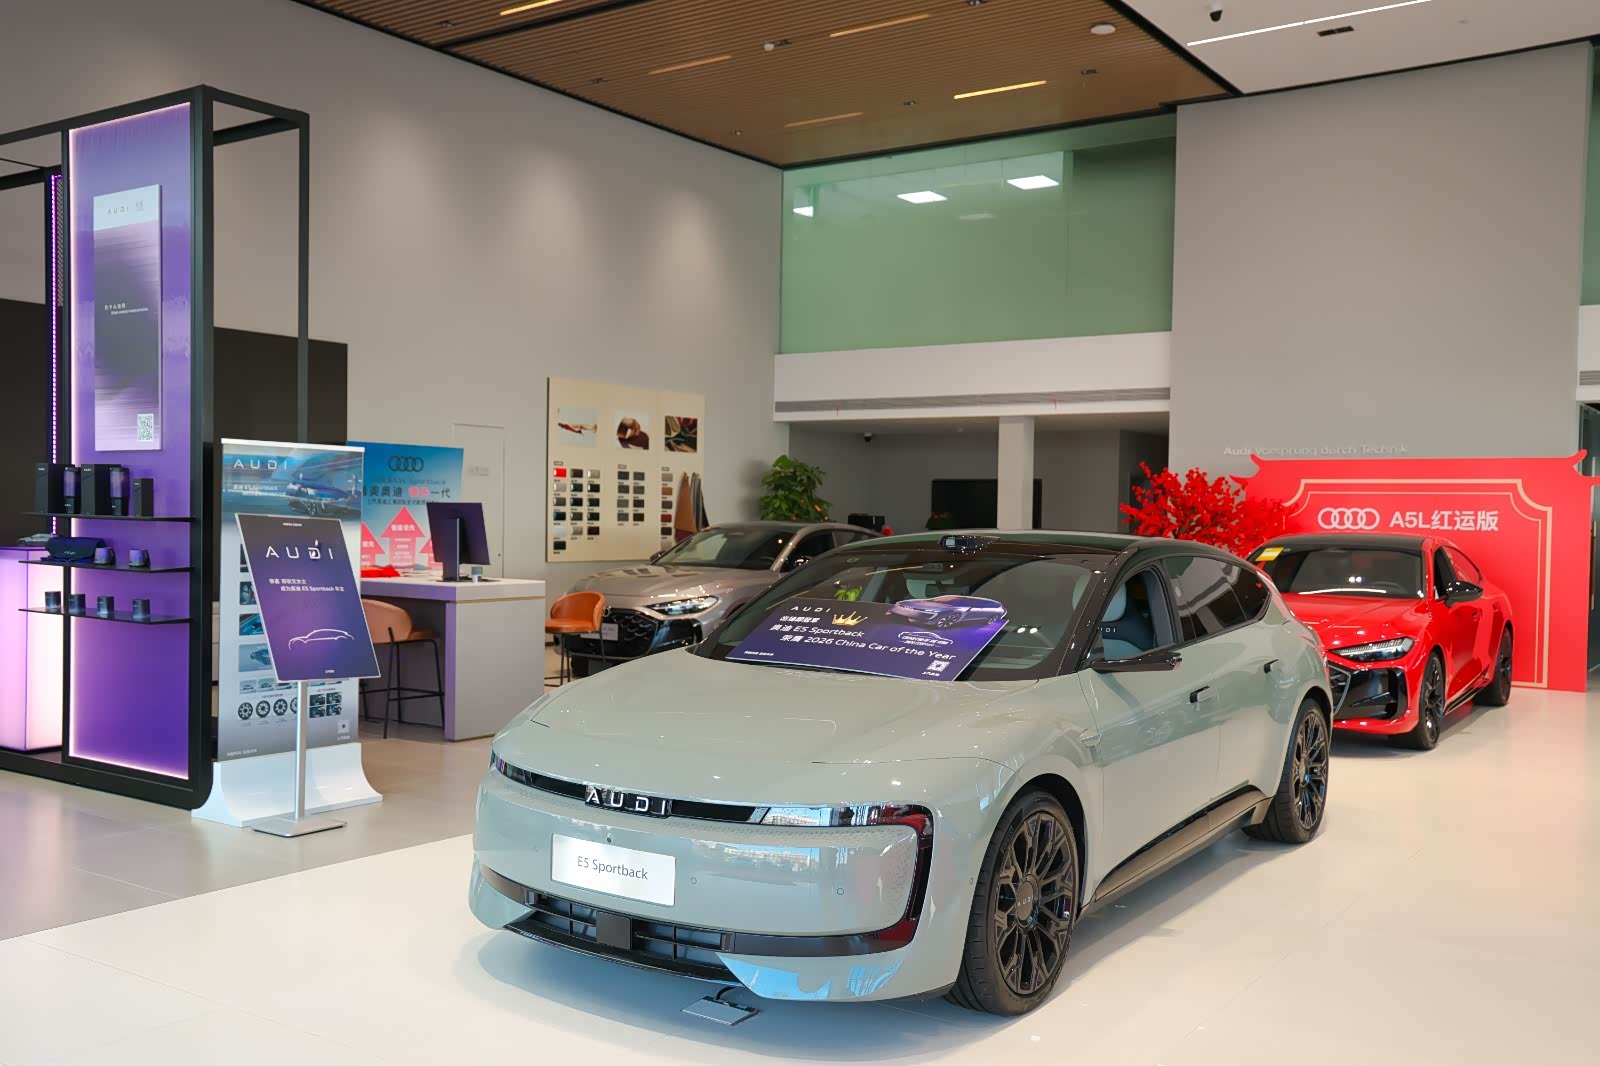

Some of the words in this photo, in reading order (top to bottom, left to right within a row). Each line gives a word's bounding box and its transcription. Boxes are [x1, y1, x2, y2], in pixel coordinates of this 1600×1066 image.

[233, 459, 287, 470] AUDI
[1389, 510, 1499, 532] A5L红运版
[265, 546, 334, 560] AUDI
[809, 627, 865, 638] Sportback
[803, 636, 835, 645] 2026
[835, 639, 867, 648] China
[868, 642, 889, 651] Car
[889, 646, 906, 654] of
[904, 648, 925, 656] the
[928, 650, 957, 660] Year
[586, 789, 666, 815] AUDI
[577, 855, 589, 869] E5
[593, 859, 648, 881] Sportback
